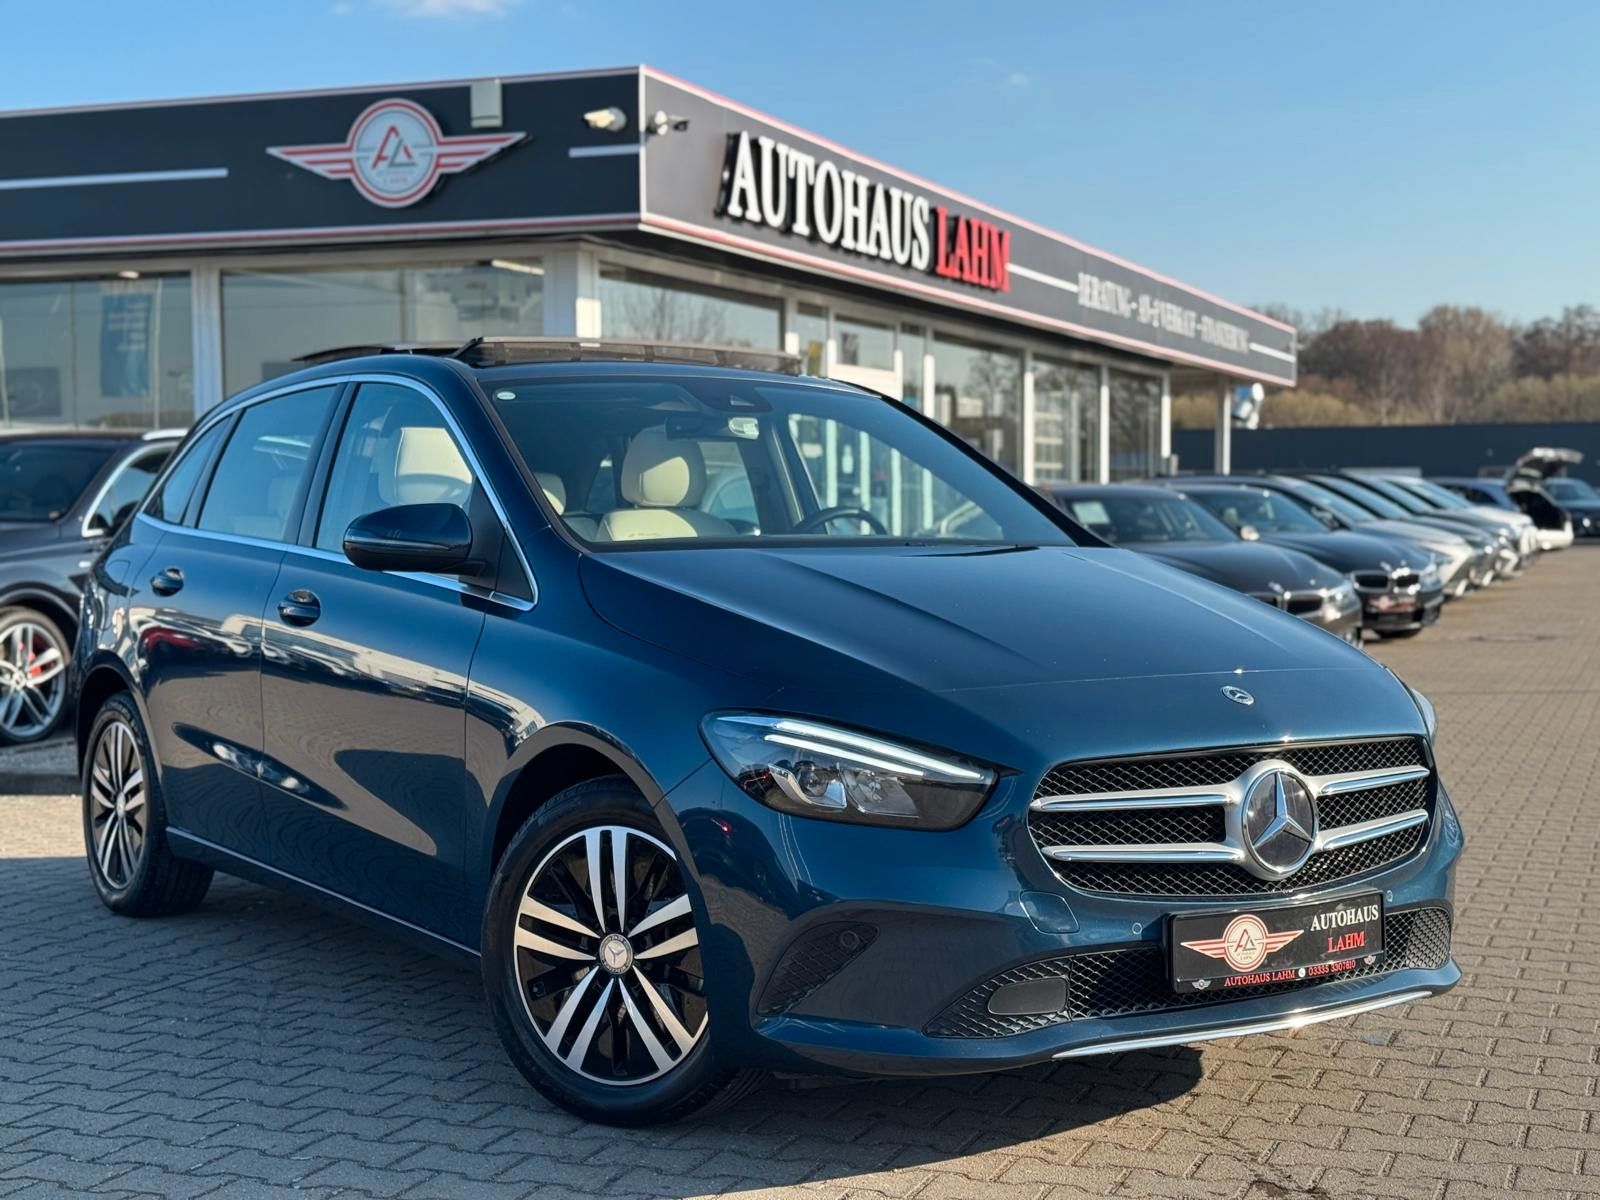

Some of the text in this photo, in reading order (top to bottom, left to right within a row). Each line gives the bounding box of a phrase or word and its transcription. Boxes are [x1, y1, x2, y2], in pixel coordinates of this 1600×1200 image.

[726, 130, 1011, 293] AUTOHAUS LAHM
[1310, 904, 1379, 932] AUTOHAUS
[1327, 930, 1365, 953] LAHM
[1224, 972, 1270, 987] AUTOHAUS
[1272, 969, 1296, 981] LAHM
